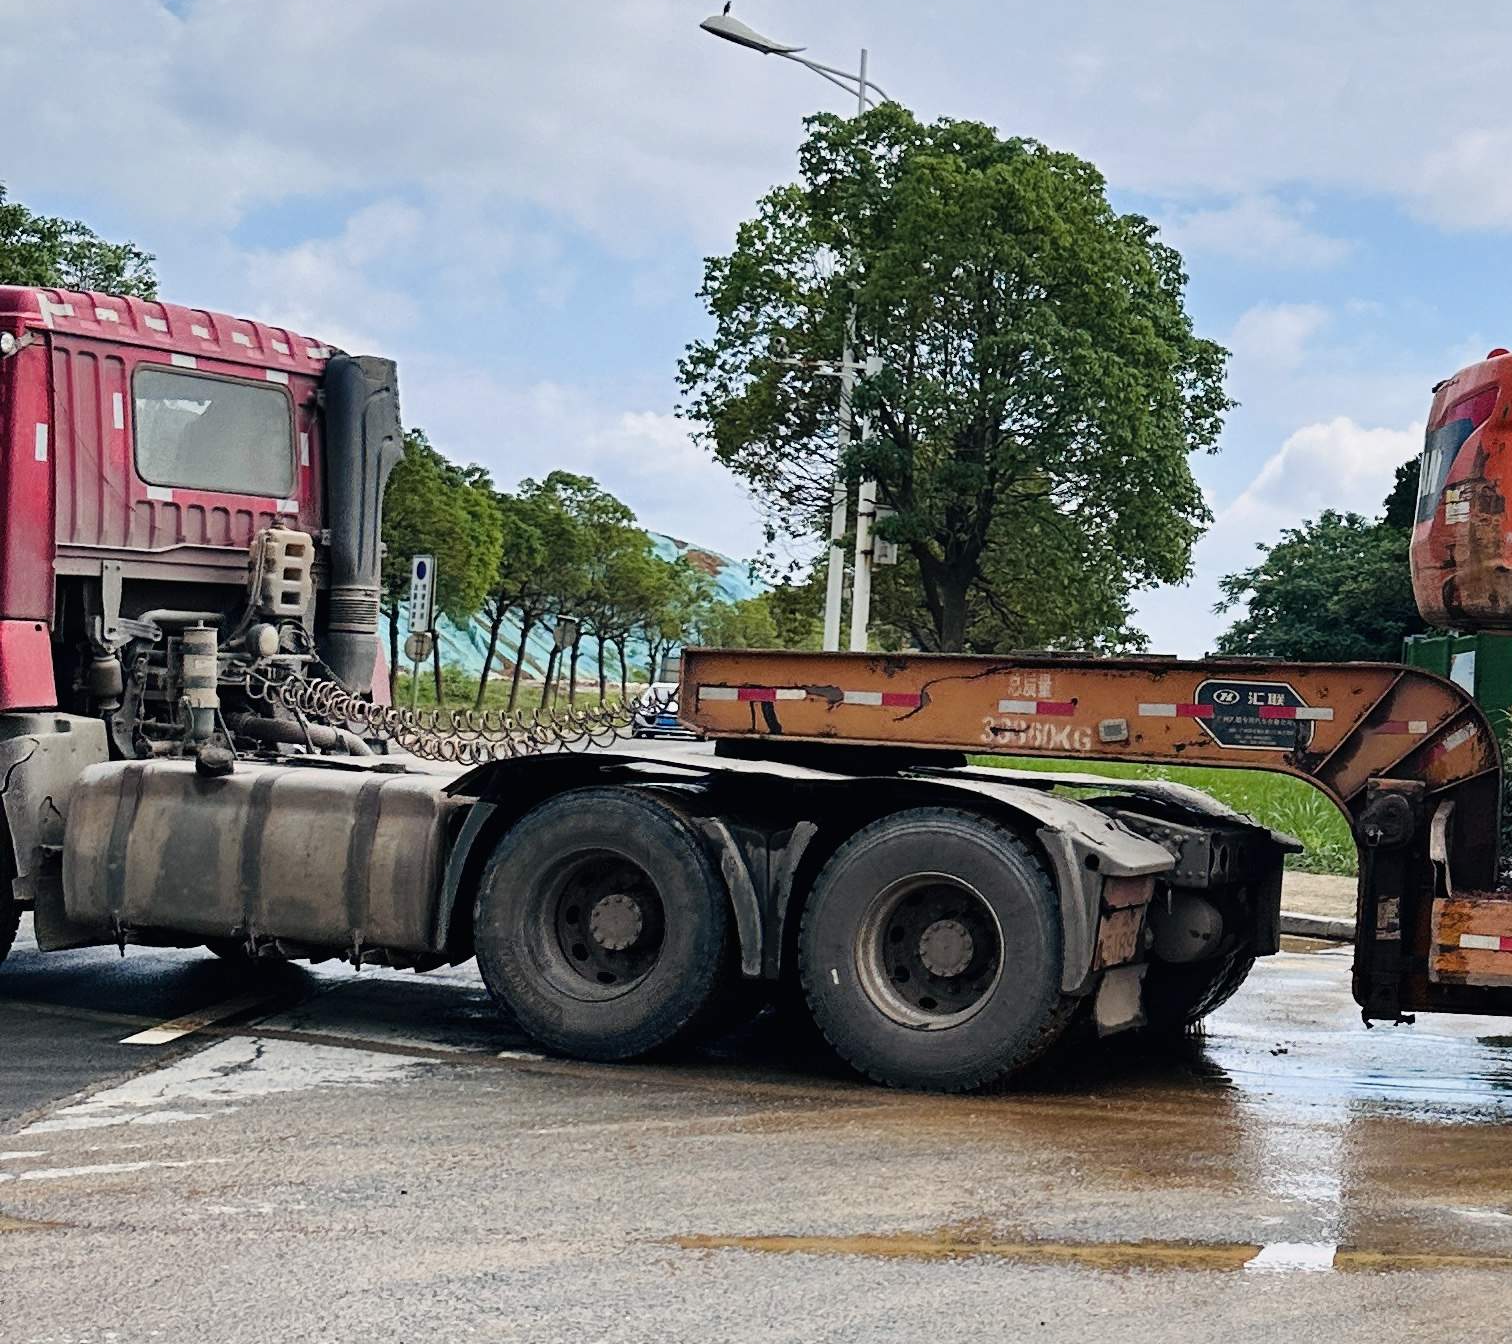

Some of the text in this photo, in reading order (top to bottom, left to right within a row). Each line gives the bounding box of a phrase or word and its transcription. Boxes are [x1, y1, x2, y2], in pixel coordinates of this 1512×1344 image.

[1008, 673, 1051, 698] 总质量
[1247, 691, 1285, 706] 汇联
